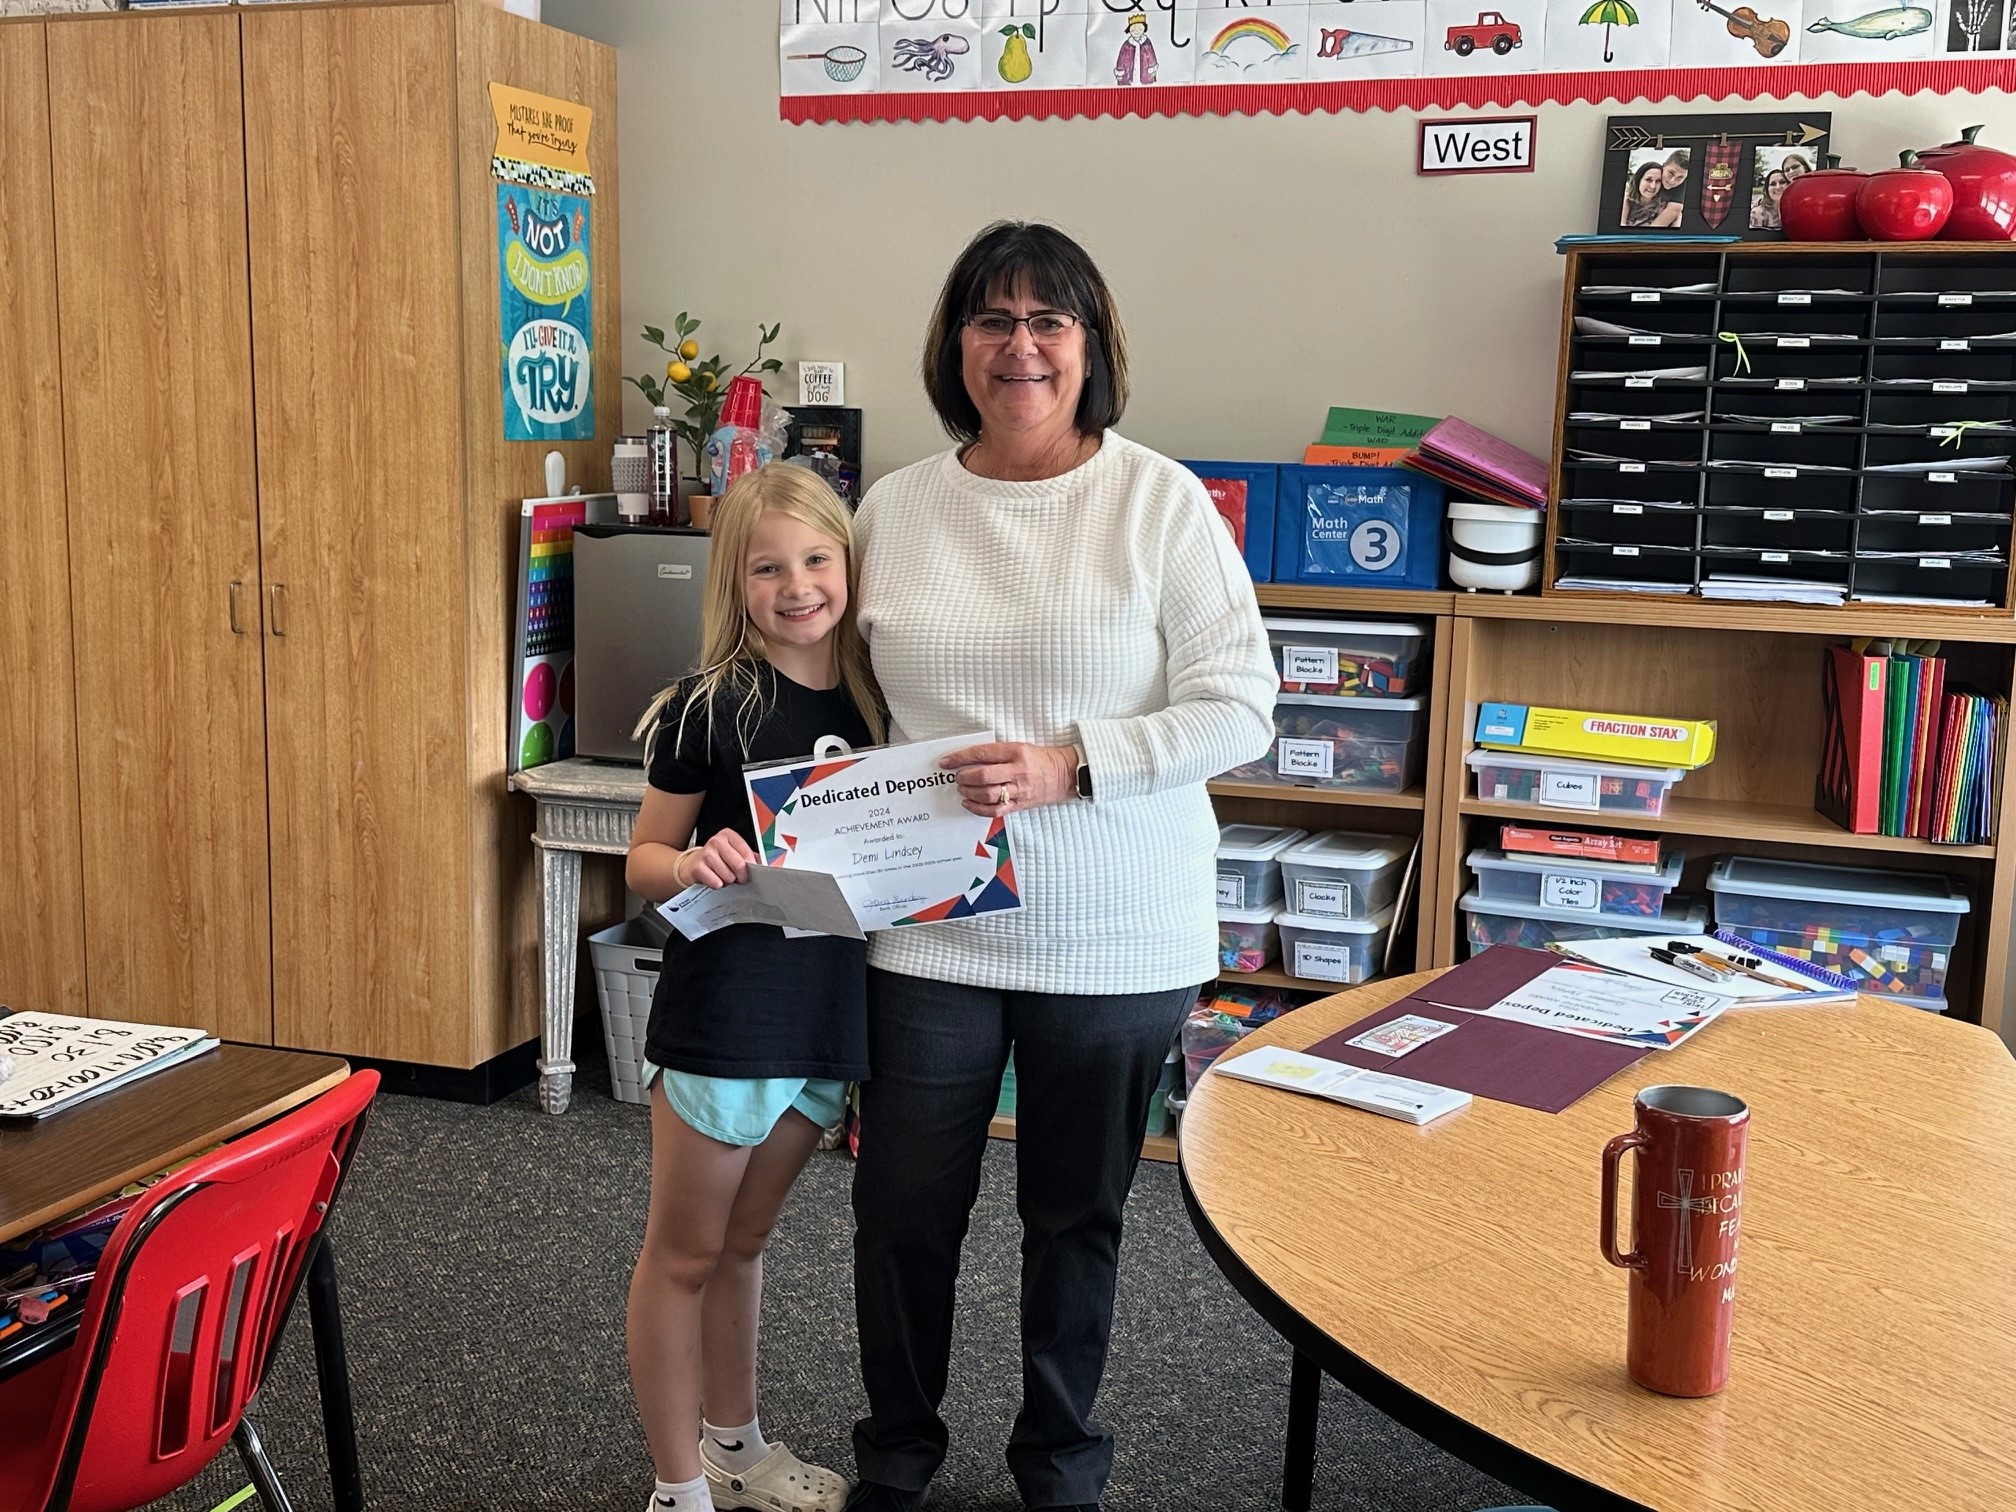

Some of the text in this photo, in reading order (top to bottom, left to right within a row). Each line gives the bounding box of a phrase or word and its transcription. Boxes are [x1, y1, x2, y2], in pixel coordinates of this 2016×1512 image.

[510, 104, 574, 134] MISTAKES ARE PROOF
[1434, 131, 1523, 163] West
[536, 196, 558, 216] IT'S
[525, 213, 565, 255] NOT
[512, 250, 584, 297] I DON'T KNOW
[522, 325, 577, 355] I'LL GIVE IT A
[804, 374, 832, 385] COFFEE
[808, 391, 829, 402] DOG
[1376, 415, 1397, 424] WAR
[1352, 452, 1380, 460] BUMP!
[1358, 495, 1384, 504] Math
[1312, 517, 1348, 529] Math
[1312, 530, 1347, 539] Center
[1364, 527, 1388, 563] 3
[1294, 656, 1325, 664] Pattern
[1296, 666, 1323, 674] Blocks
[1590, 720, 1678, 740] FRACTION STAX
[1290, 749, 1320, 758] Pattern
[1291, 759, 1318, 768] Blocks
[1556, 780, 1583, 790] Cubes
[800, 782, 880, 808] Dedicated
[868, 807, 891, 818] 2024
[834, 812, 930, 836] ACHIEVEMENT AWARD
[864, 834, 895, 846] Awarded
[1584, 836, 1608, 849] Array
[1609, 838, 1622, 849] Set
[852, 846, 923, 866] Demi Lindsey
[1309, 892, 1336, 902] Clocks
[1558, 887, 1583, 896] Color
[1560, 898, 1580, 906] Tiles
[1314, 956, 1342, 966] Shapes
[1554, 1011, 1635, 1033] Dedicated
[8, 1025, 81, 1056] 8,100
[51, 1029, 134, 1063] 8,130
